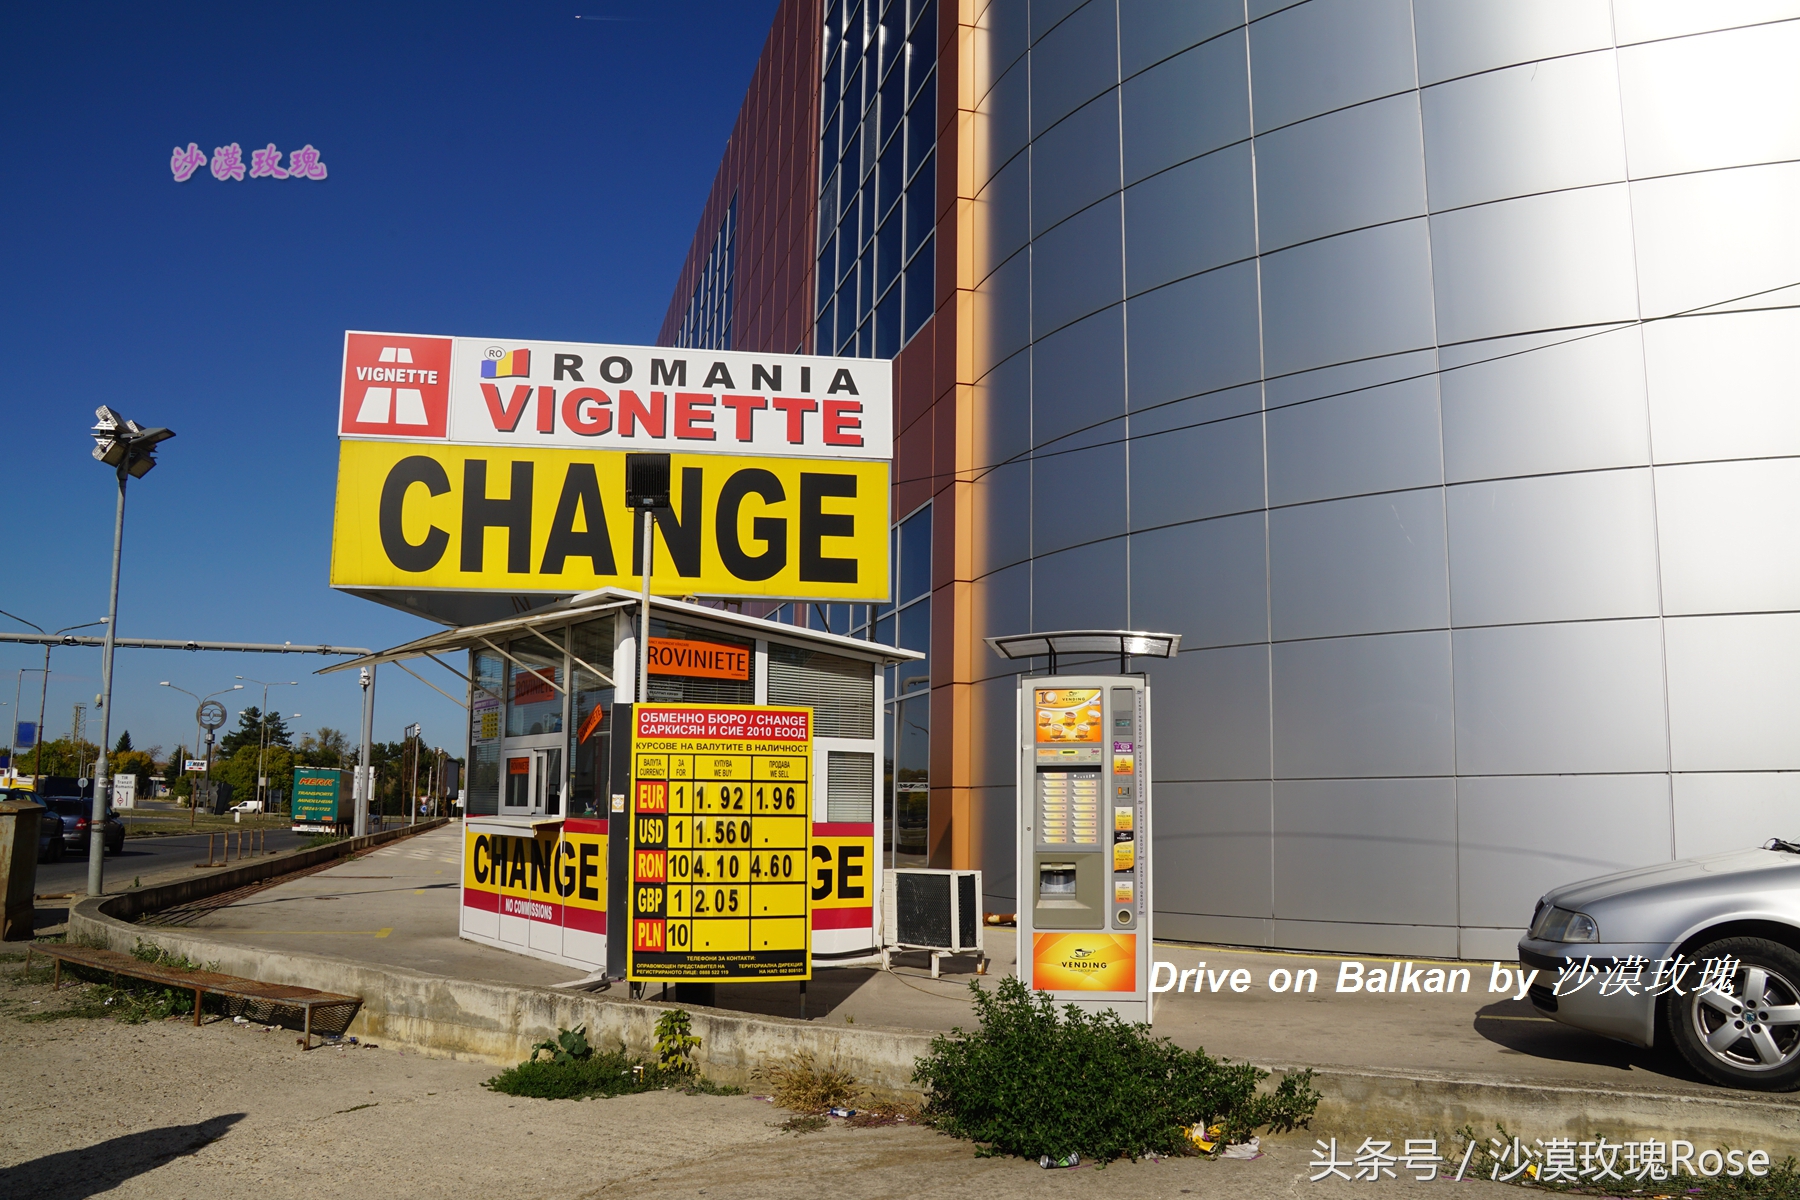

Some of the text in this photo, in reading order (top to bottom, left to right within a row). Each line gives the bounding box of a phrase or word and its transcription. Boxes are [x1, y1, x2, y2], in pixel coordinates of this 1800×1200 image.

[488, 349, 503, 358] RO
[356, 366, 438, 385] VIGNETTE
[553, 353, 859, 396] ROMANIA
[480, 382, 864, 448] VIGNETTE
[379, 455, 858, 584] CHANGE
[648, 646, 746, 672] ROVINIETE
[640, 712, 806, 726] ОБМЕННО БЮРО / CHANGE
[641, 724, 806, 739] САРКИСЯН И СИЕ 2010 ЕООД
[635, 742, 677, 750] КУРСОВЕ
[681, 742, 693, 751] НА
[696, 743, 744, 751] ВАЛУТИТЕ
[755, 744, 808, 753] НАЛИЧНОСТ
[640, 768, 665, 776] CURRENCY
[643, 758, 662, 767] ВАЛУТА
[676, 769, 686, 777] FOR
[713, 769, 732, 777] WE BUY
[714, 759, 732, 767] КУПУВА
[769, 760, 790, 769] ПРОДАВА
[770, 770, 789, 778] WE SELL
[298, 777, 335, 786] MERK
[639, 784, 665, 809] EUR
[675, 786, 684, 809] 1
[756, 786, 795, 810] 1.96
[639, 819, 664, 844] USD
[675, 820, 684, 843] 1
[695, 820, 750, 844] 1.560
[474, 835, 599, 901] CHANGE
[638, 853, 664, 878] RON
[669, 854, 689, 877] 10
[693, 855, 739, 878] 4.10
[751, 854, 792, 877] 4.60
[505, 898, 552, 921] NO COMMISSIONS
[638, 887, 663, 912] GBP
[674, 889, 682, 912] 1
[695, 889, 738, 912] 2.05
[638, 922, 662, 947] PLN
[668, 924, 688, 947] 10
[1062, 961, 1107, 969] VENDING
